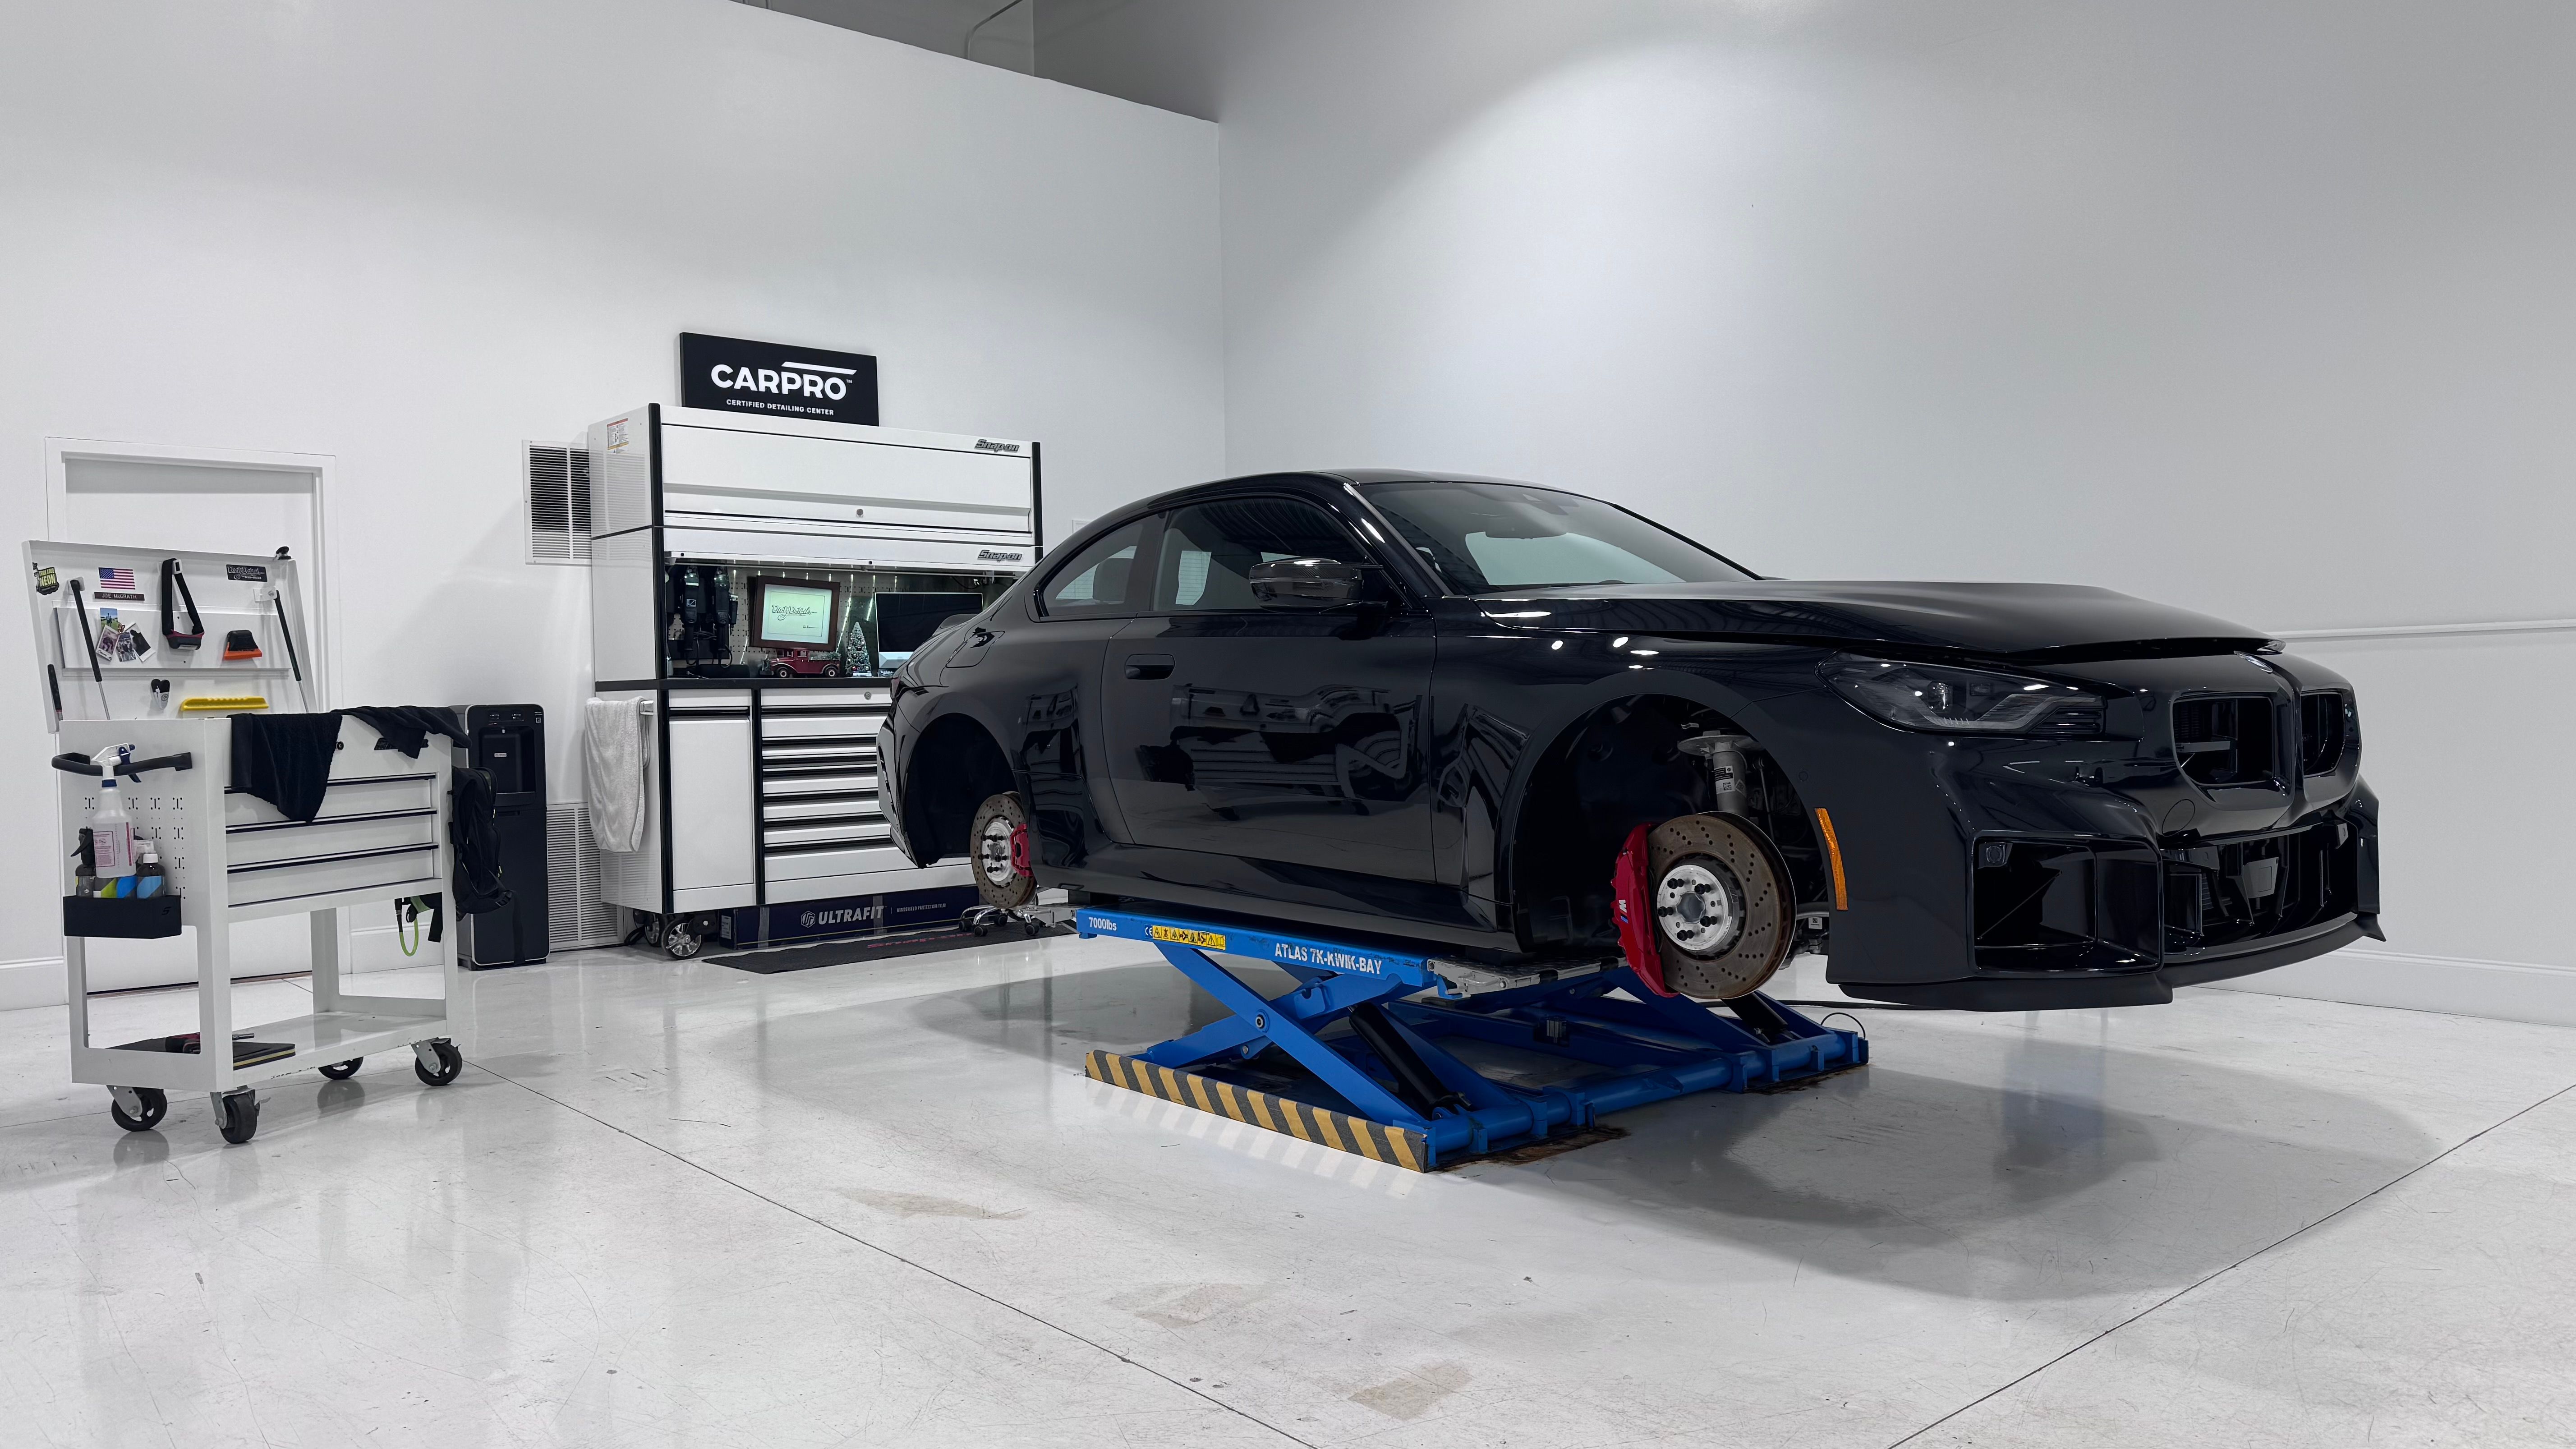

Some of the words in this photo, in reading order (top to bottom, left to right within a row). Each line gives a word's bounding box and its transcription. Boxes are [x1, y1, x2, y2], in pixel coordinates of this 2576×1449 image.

[711, 364, 846, 400] CARPRO
[726, 399, 765, 409] CERTIFIED
[767, 403, 805, 412] DETAILING
[807, 407, 834, 416] CENTER
[975, 439, 1020, 453] Snap-on
[978, 550, 1022, 562] Snap-on
[40, 574, 56, 587] NEON
[818, 906, 884, 925] ULTRAFIT
[1088, 917, 1117, 931] 7000lbs
[1275, 943, 1308, 961] ATLAS
[1310, 948, 1382, 975] 7K-KWIK-BAY
